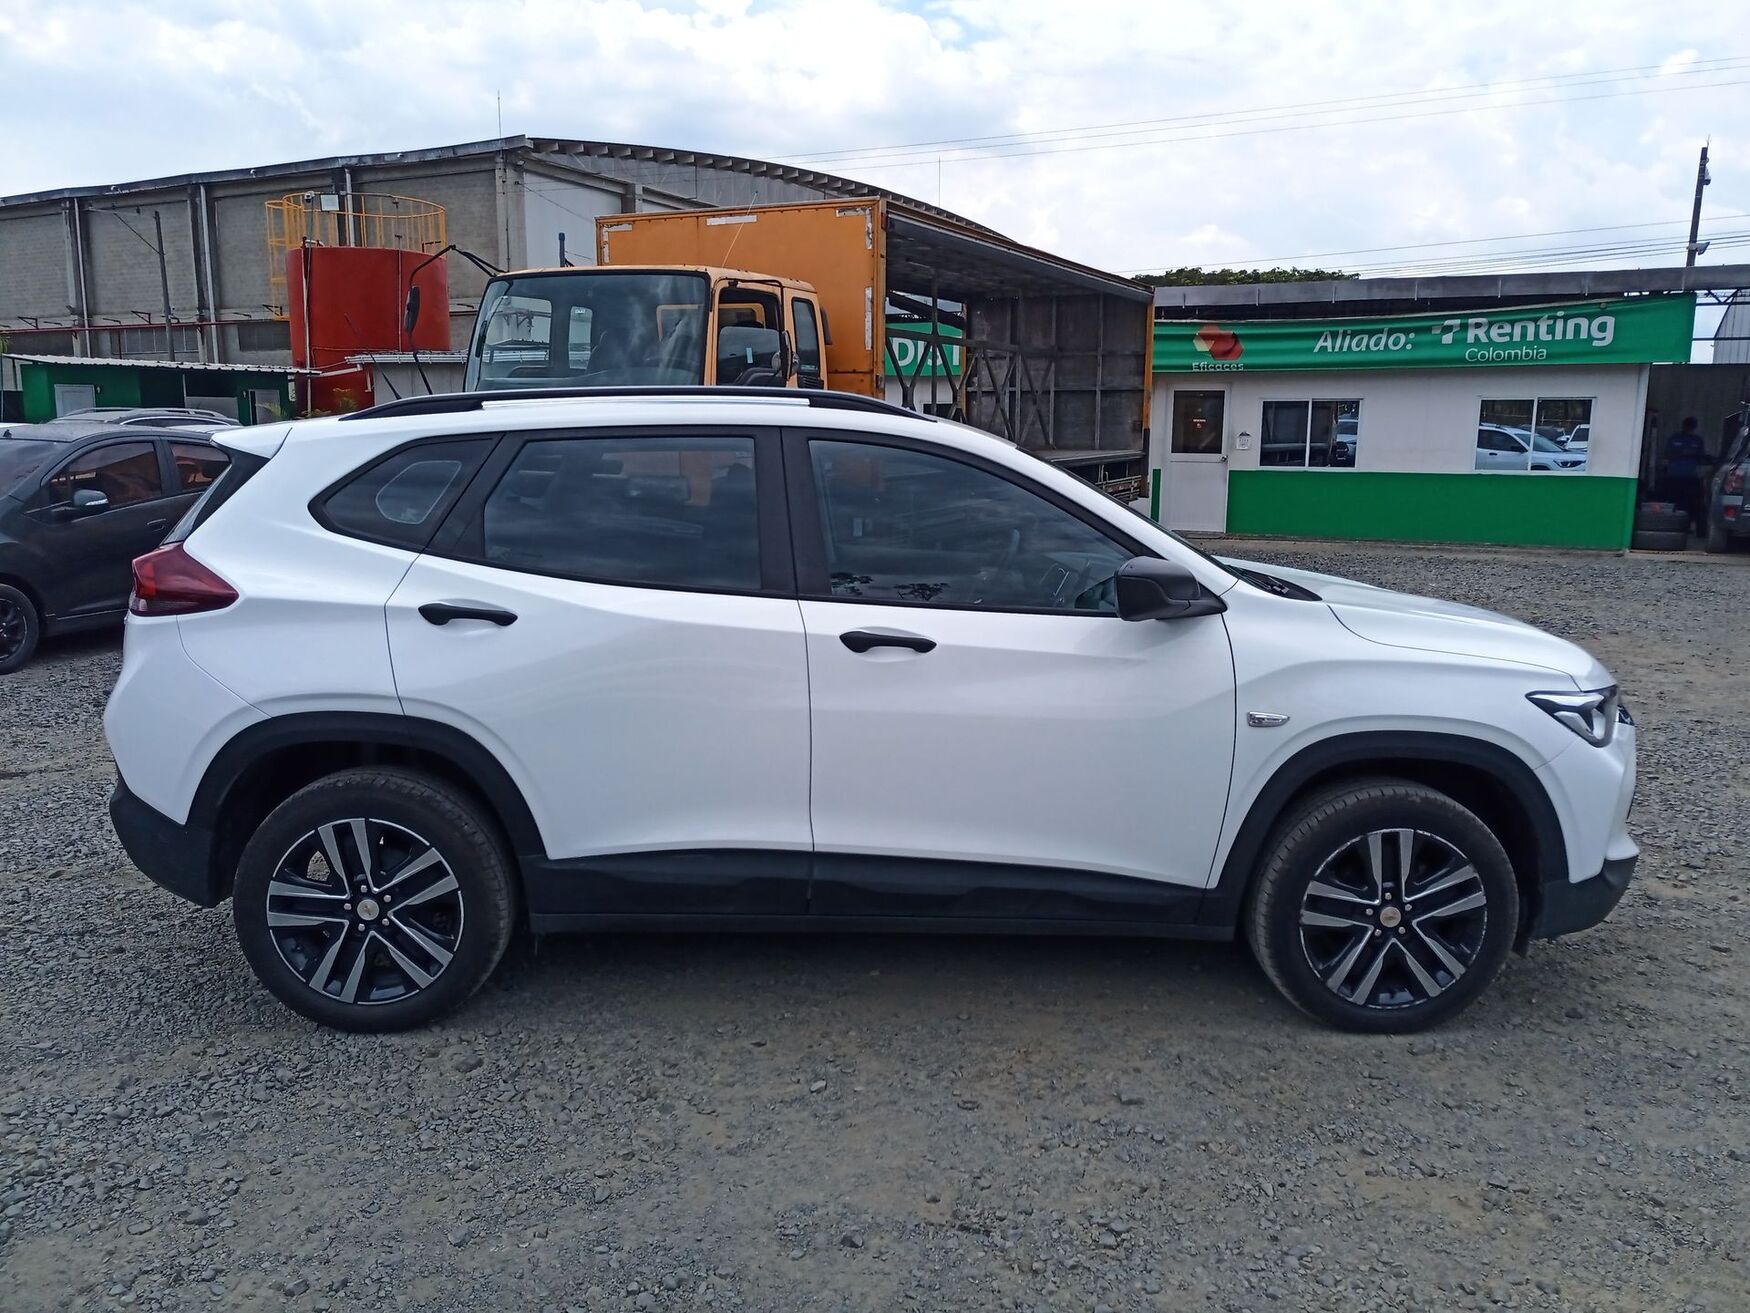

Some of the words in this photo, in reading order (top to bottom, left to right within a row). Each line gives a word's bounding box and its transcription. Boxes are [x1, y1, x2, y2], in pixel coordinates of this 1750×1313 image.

[1313, 327, 1415, 352] Aliado:
[1466, 311, 1616, 347] Renting
[1465, 345, 1547, 362] Colombia
[1192, 361, 1244, 371] Eficaces
